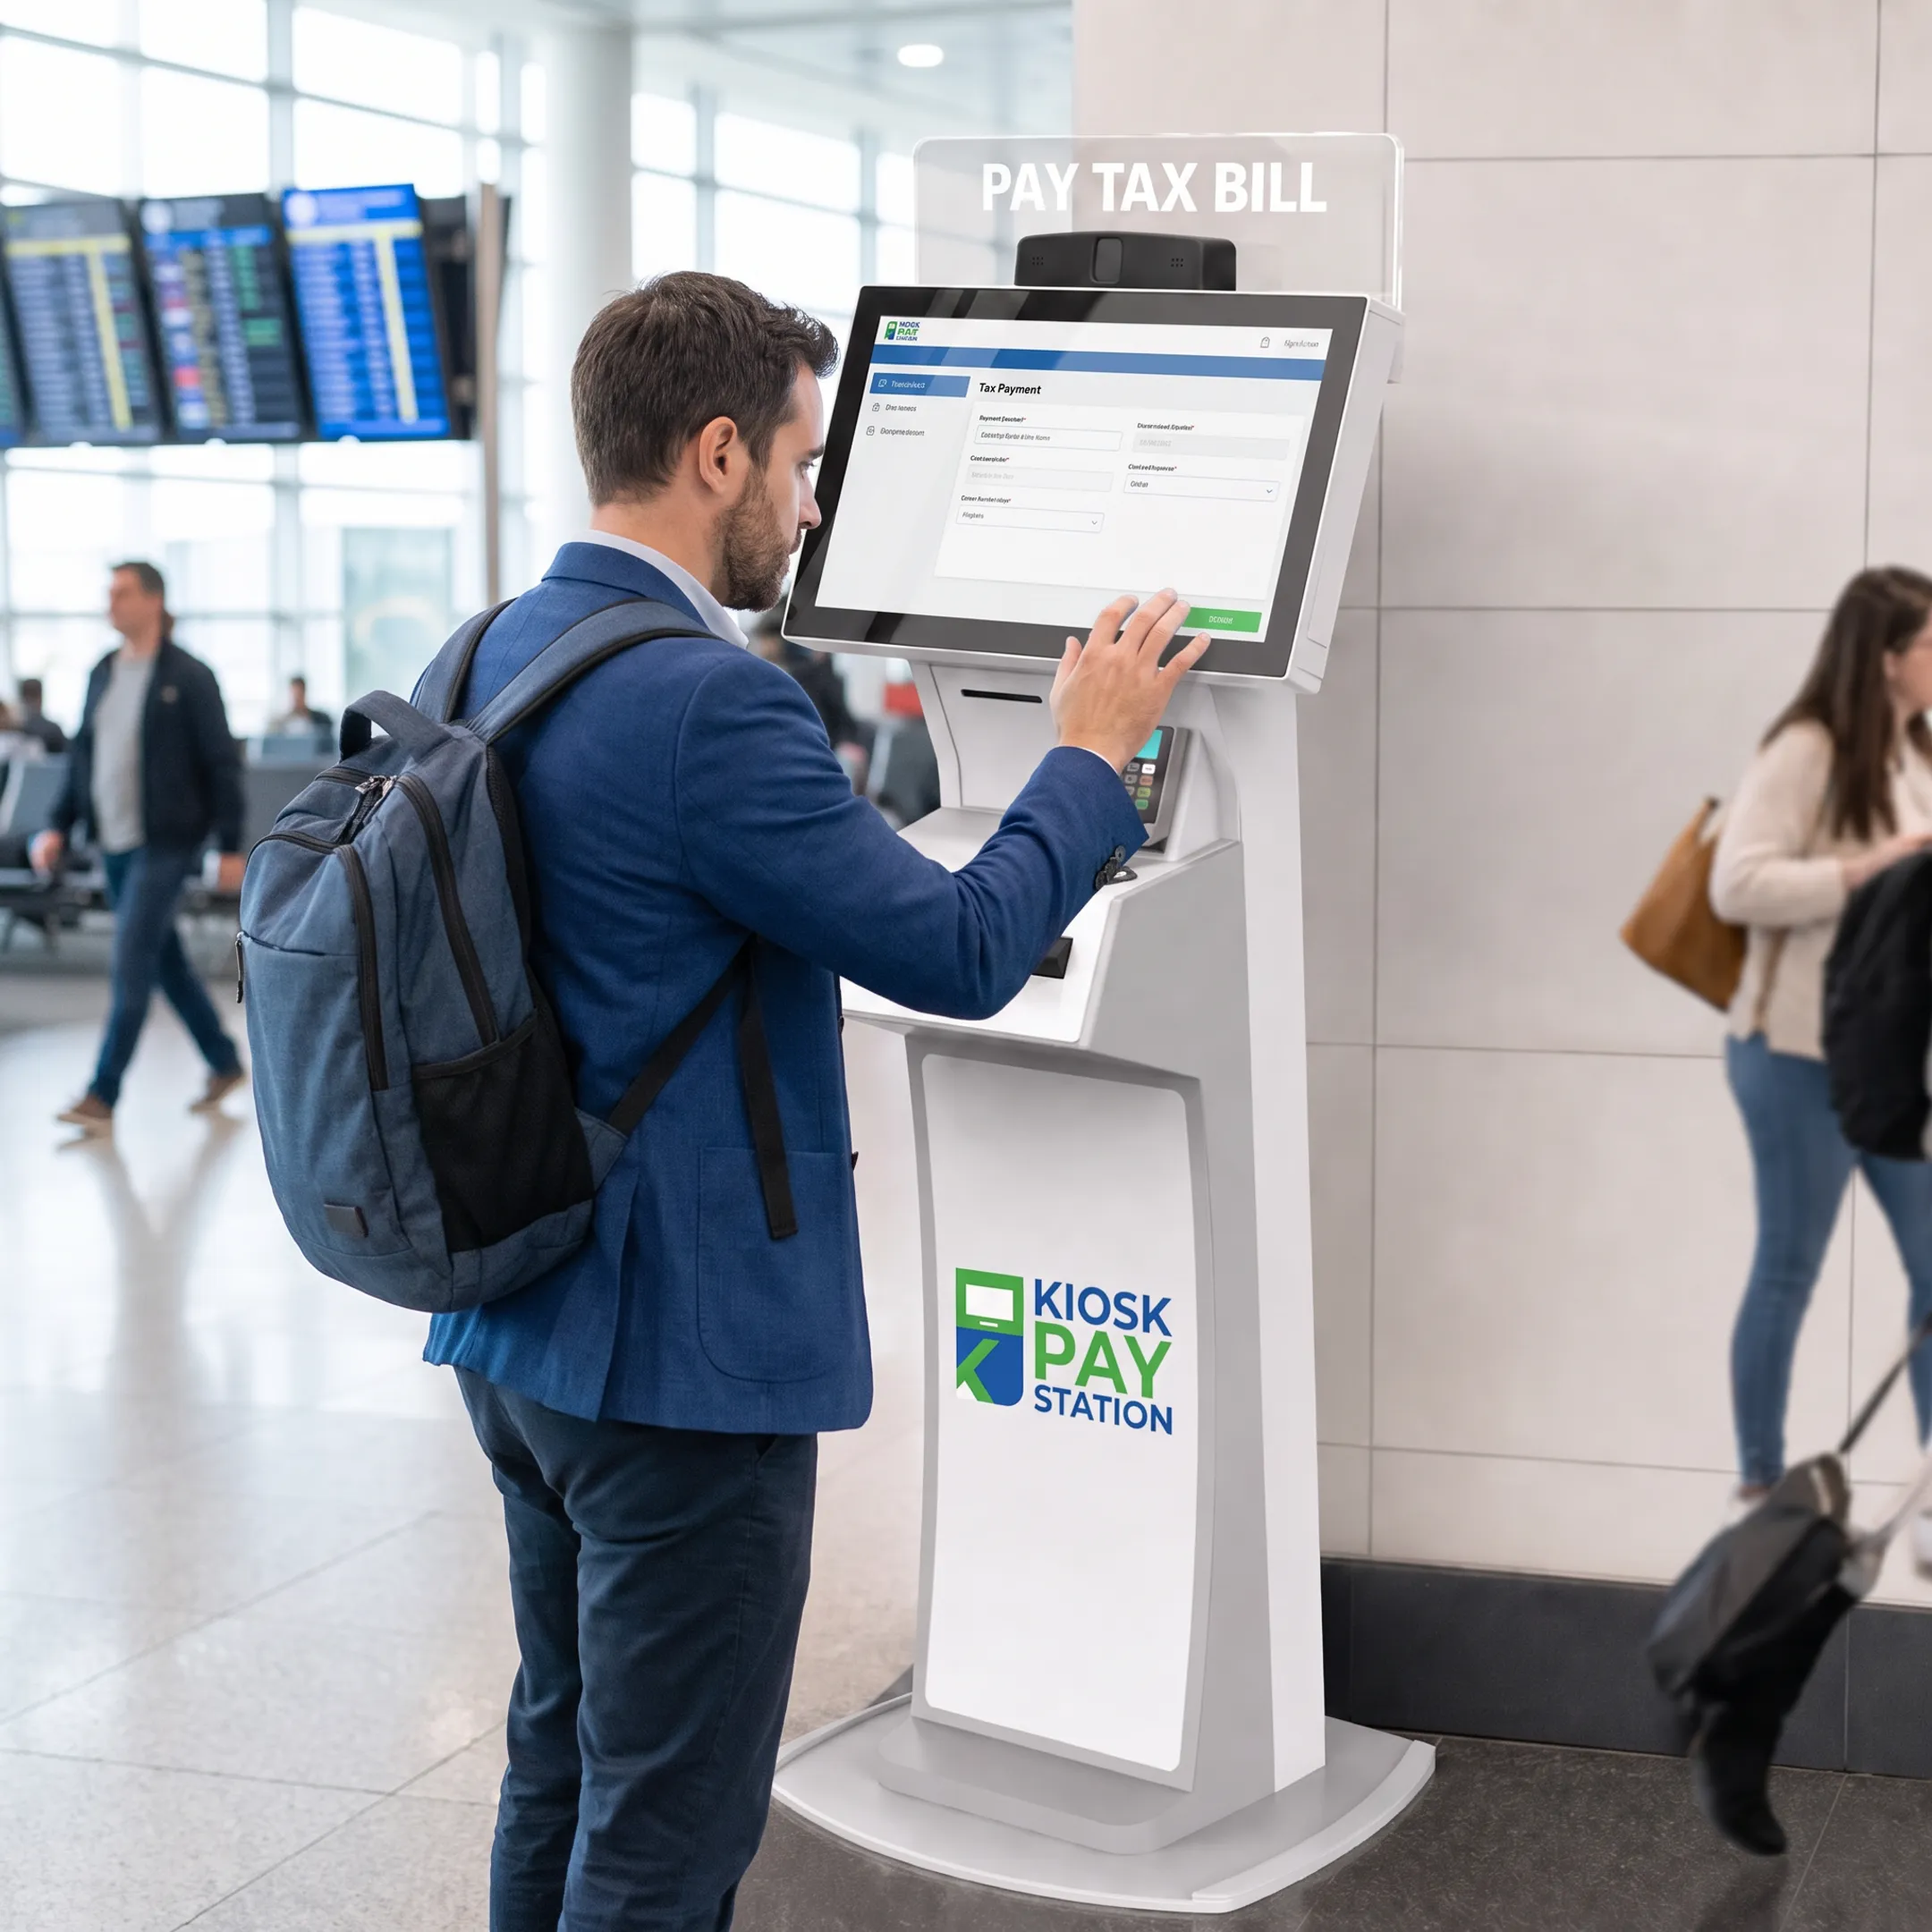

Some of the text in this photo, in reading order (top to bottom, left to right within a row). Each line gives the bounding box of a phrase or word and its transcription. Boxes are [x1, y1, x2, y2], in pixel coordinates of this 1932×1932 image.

[982, 162, 1327, 213] PAY TAX BILL
[979, 383, 1042, 396] Tax Payment
[1034, 1278, 1173, 1337] KIOSK
[1034, 1320, 1173, 1399] PAY
[1034, 1384, 1174, 1436] STATION
